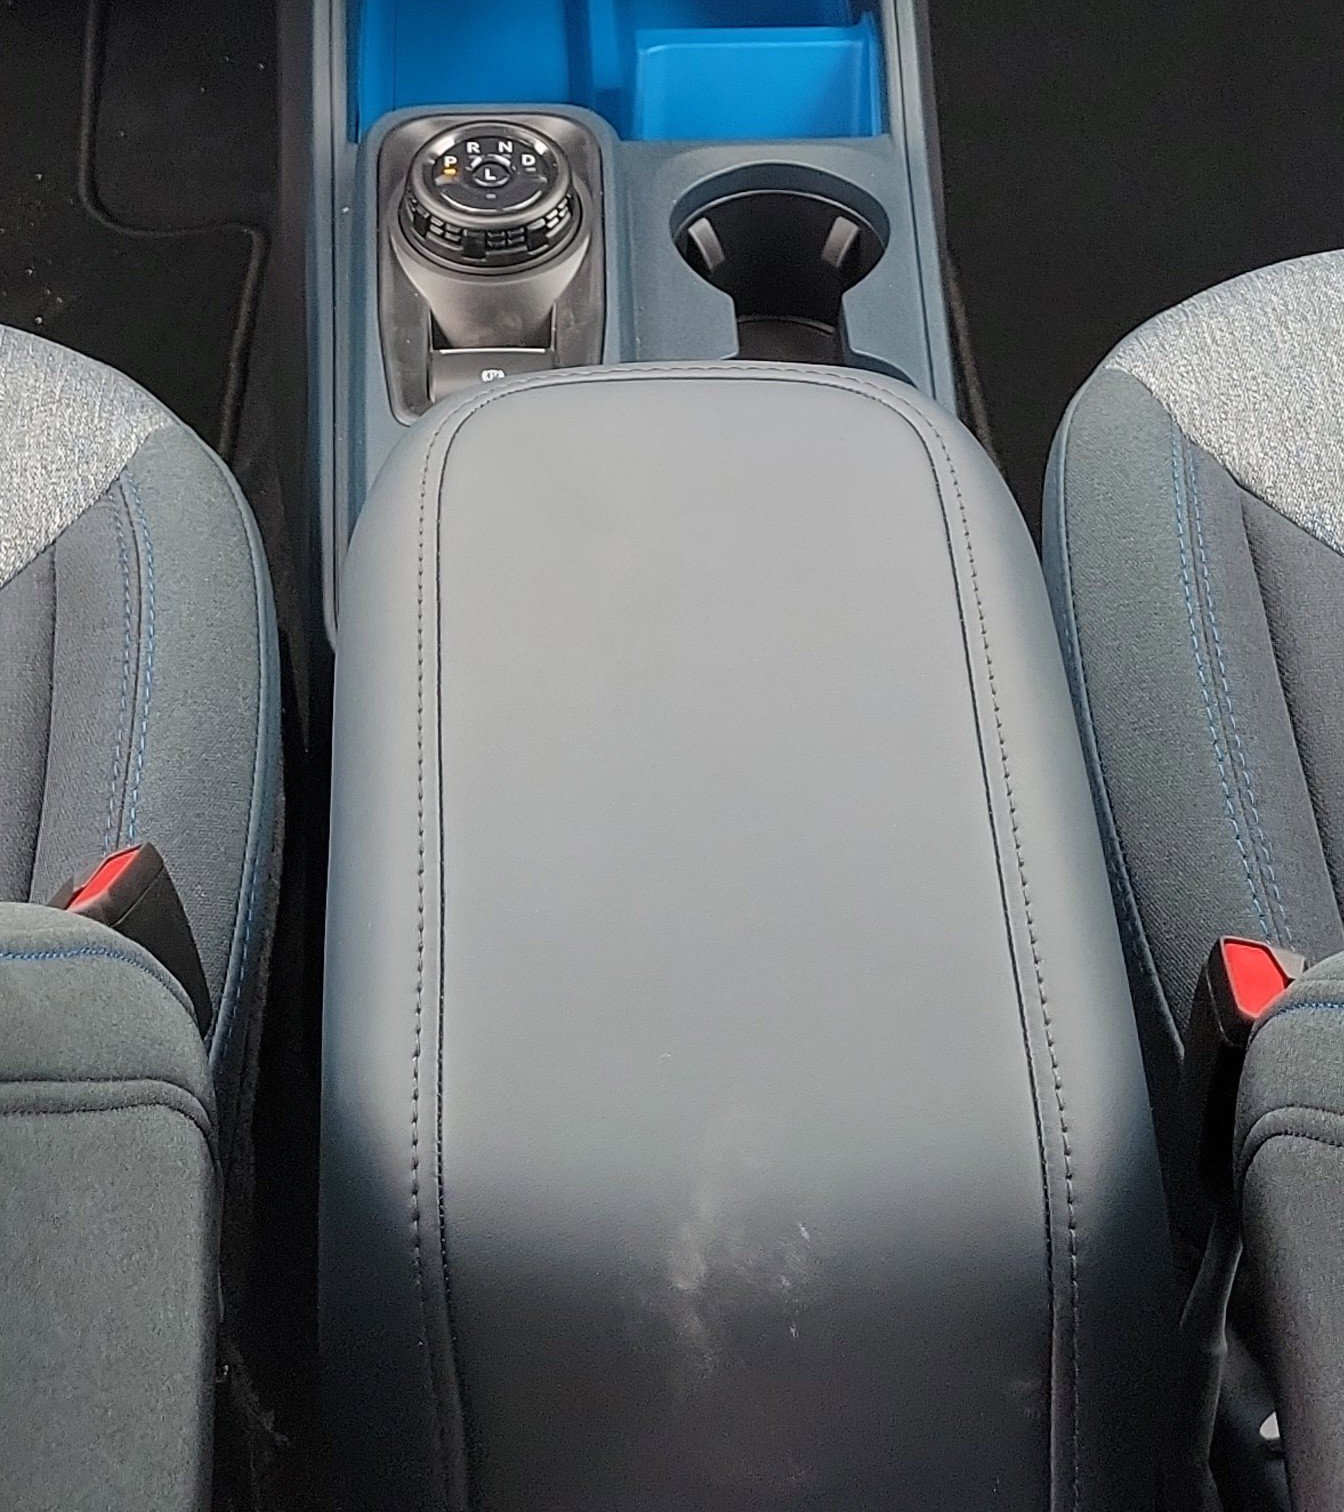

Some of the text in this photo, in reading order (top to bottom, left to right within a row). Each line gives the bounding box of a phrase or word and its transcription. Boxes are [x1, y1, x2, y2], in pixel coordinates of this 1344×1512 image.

[466, 141, 481, 154] R
[498, 141, 513, 153] N
[443, 155, 457, 168] P
[521, 154, 536, 167] D
[484, 168, 497, 181] L
